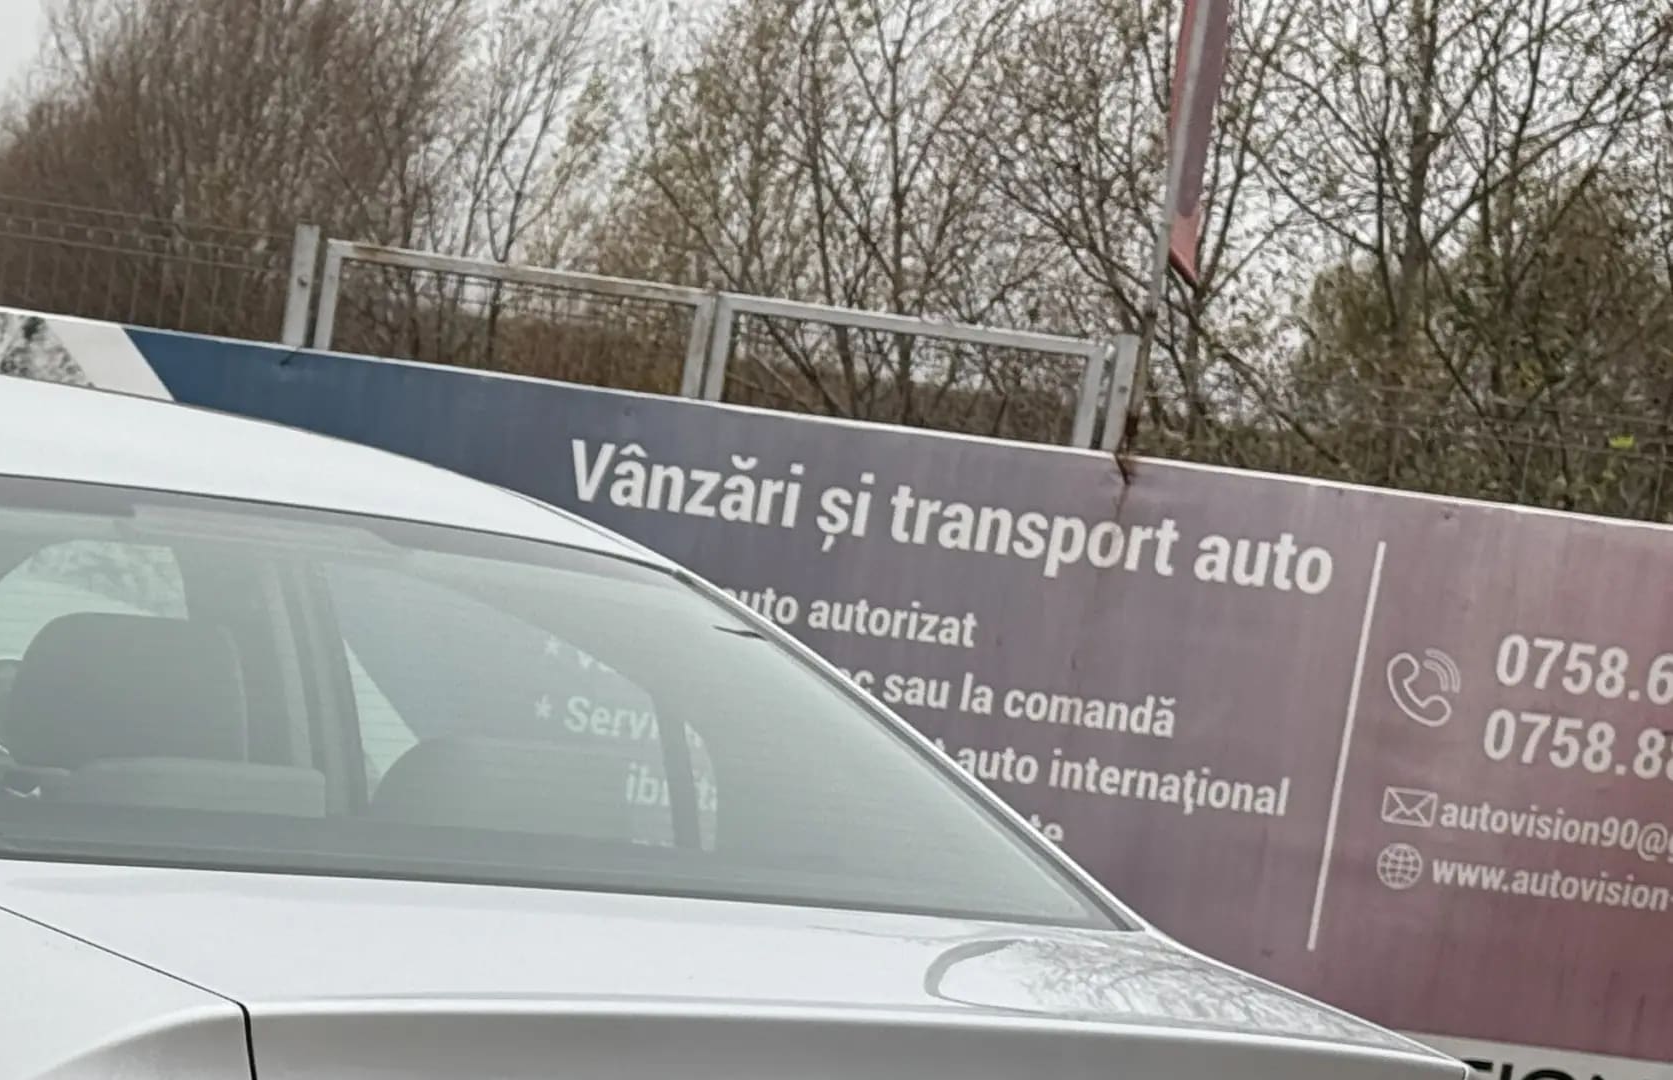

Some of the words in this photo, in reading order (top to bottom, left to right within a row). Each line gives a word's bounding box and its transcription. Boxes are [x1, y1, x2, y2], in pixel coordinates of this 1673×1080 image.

[571, 438, 805, 528] Vânzări
[816, 472, 875, 551] și
[890, 485, 1179, 577] transport
[1194, 533, 1333, 594] auto
[807, 599, 978, 648] autorizat
[882, 673, 950, 709] sau
[959, 672, 994, 715] la
[1003, 686, 1176, 738] comandă
[956, 746, 1040, 785] auto
[1483, 709, 1673, 782] 0758.8
[1440, 802, 1673, 862] autovision90@
